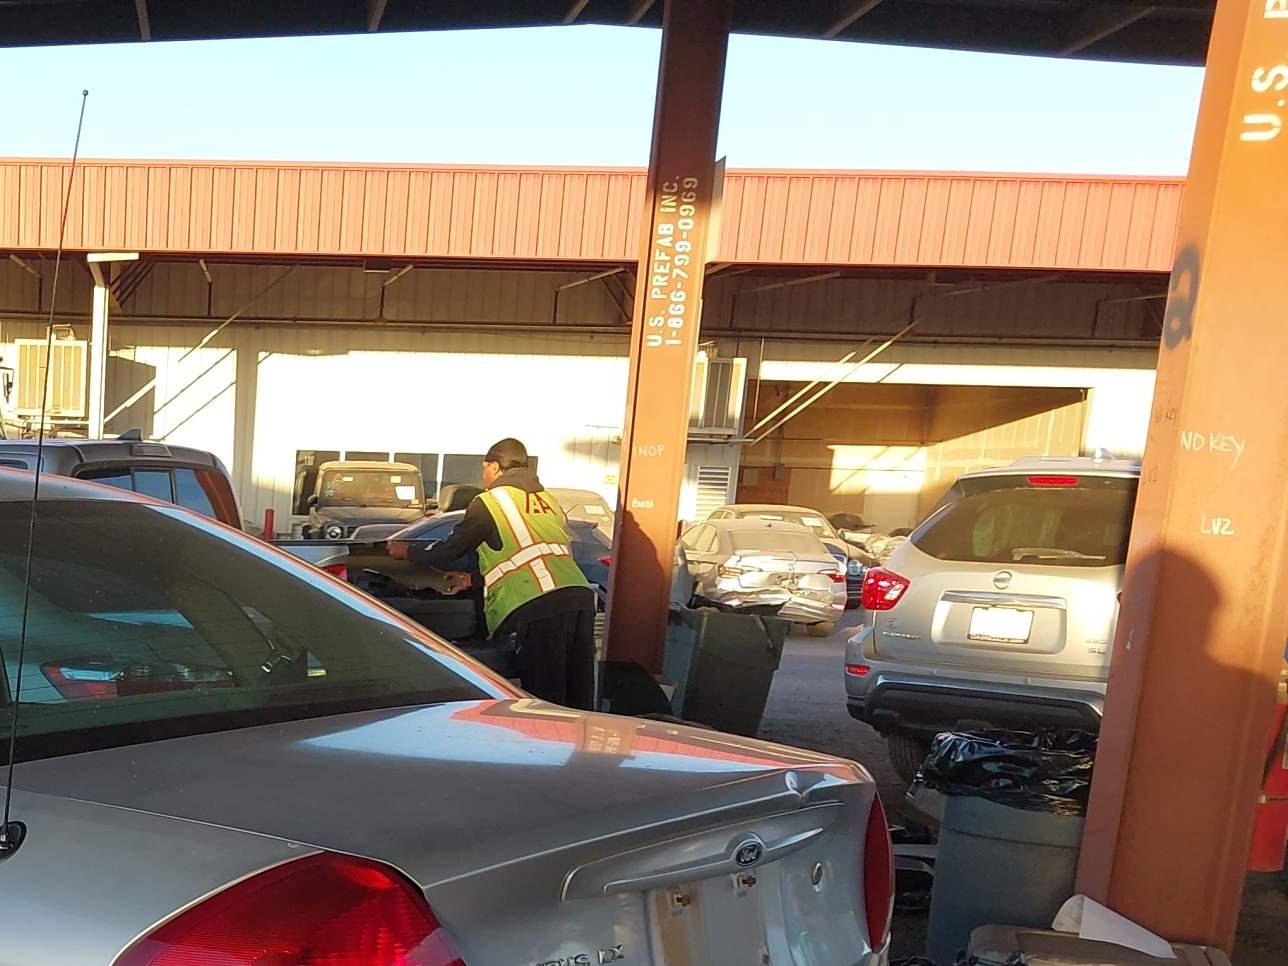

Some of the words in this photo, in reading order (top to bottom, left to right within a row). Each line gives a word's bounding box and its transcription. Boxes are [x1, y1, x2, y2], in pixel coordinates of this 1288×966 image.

[660, 175, 681, 213] INC.
[650, 223, 674, 299] PREFAB
[665, 177, 698, 346] 1-866-799-0969
[646, 310, 666, 347] U.S.
[1180, 431, 1205, 451] NO
[1209, 432, 1246, 471] KEY
[597, 944, 625, 965] LX
